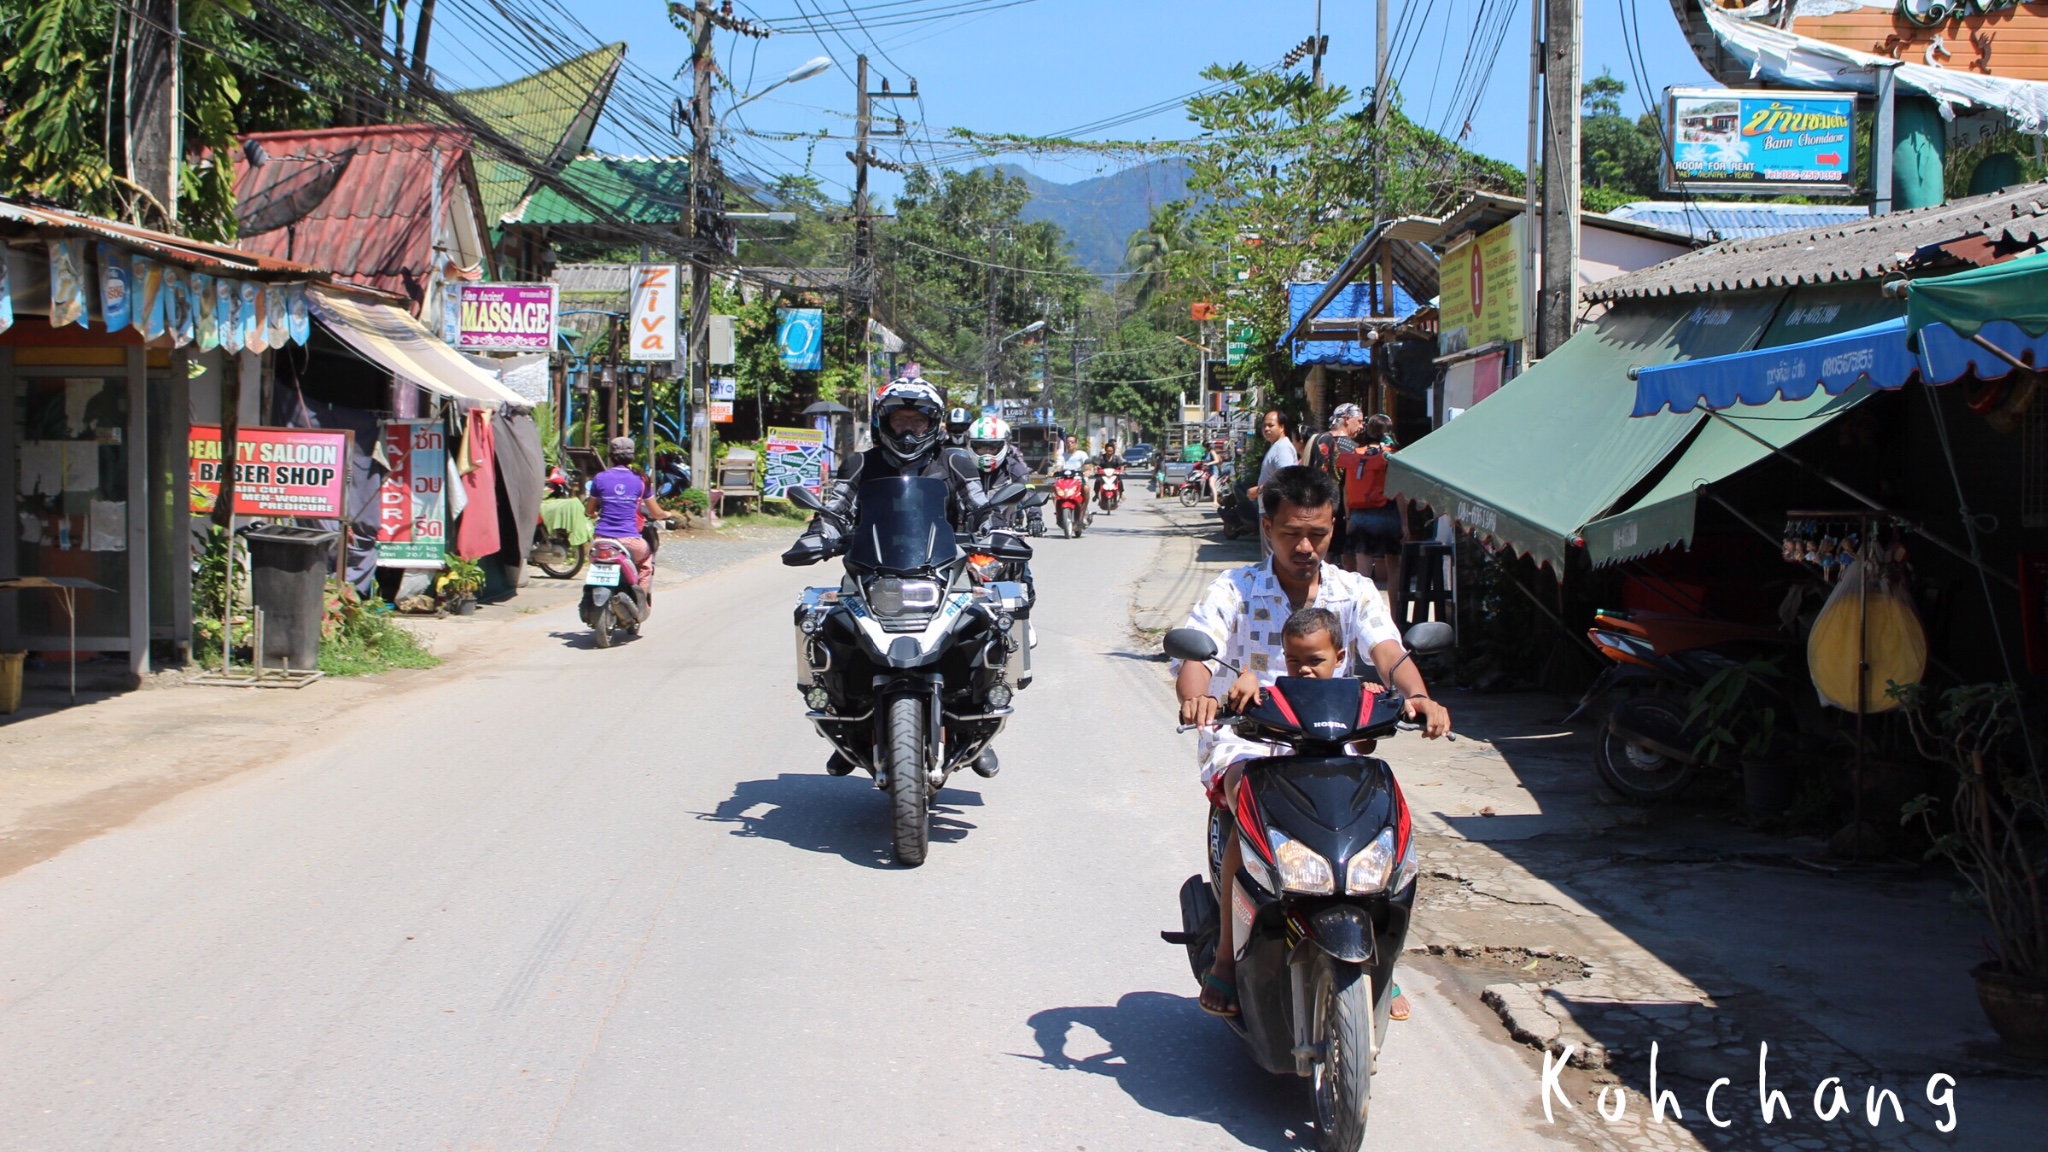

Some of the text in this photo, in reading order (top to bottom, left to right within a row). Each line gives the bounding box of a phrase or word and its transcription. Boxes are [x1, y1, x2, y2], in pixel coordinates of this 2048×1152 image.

[1763, 135, 1793, 151] Bann
[1675, 161, 1703, 170] ROOM
[1708, 162, 1726, 171] FOR
[1731, 162, 1755, 171] RENT
[461, 301, 549, 333] MASSAGE
[639, 268, 670, 350] Ziva
[415, 427, 442, 450] ซัก
[259, 442, 337, 465] SALOON
[275, 465, 336, 487] SHOP
[415, 477, 442, 494] อบ
[235, 485, 286, 494] AIR CUT
[241, 493, 327, 504] MEN-WOMEN
[258, 501, 334, 513] PREDICURE
[415, 515, 442, 537] รีด
[946, 594, 970, 617] R1200
